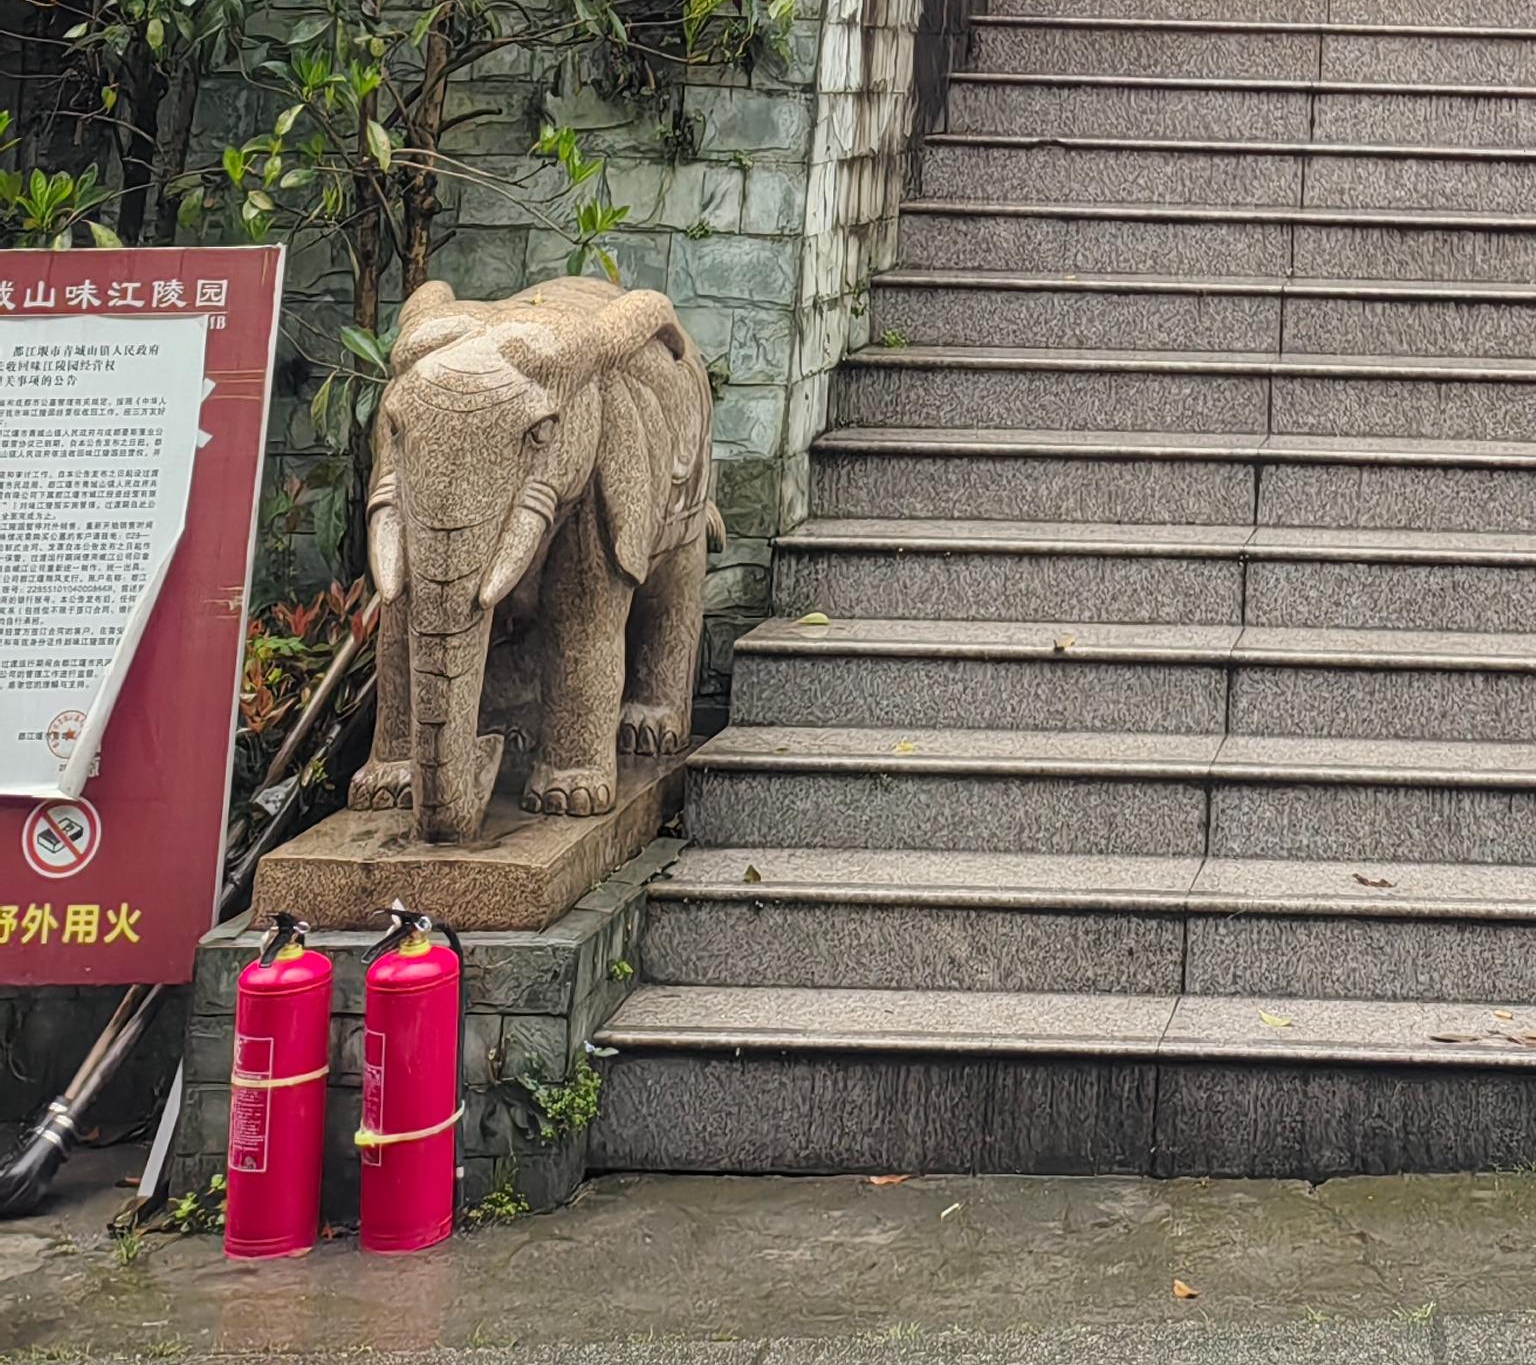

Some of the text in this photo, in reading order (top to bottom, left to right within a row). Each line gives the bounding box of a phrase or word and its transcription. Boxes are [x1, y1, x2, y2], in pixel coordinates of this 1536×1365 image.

[0, 359, 116, 372] 收回味江陵园经营权
[0, 374, 78, 387] 关事项的公告
